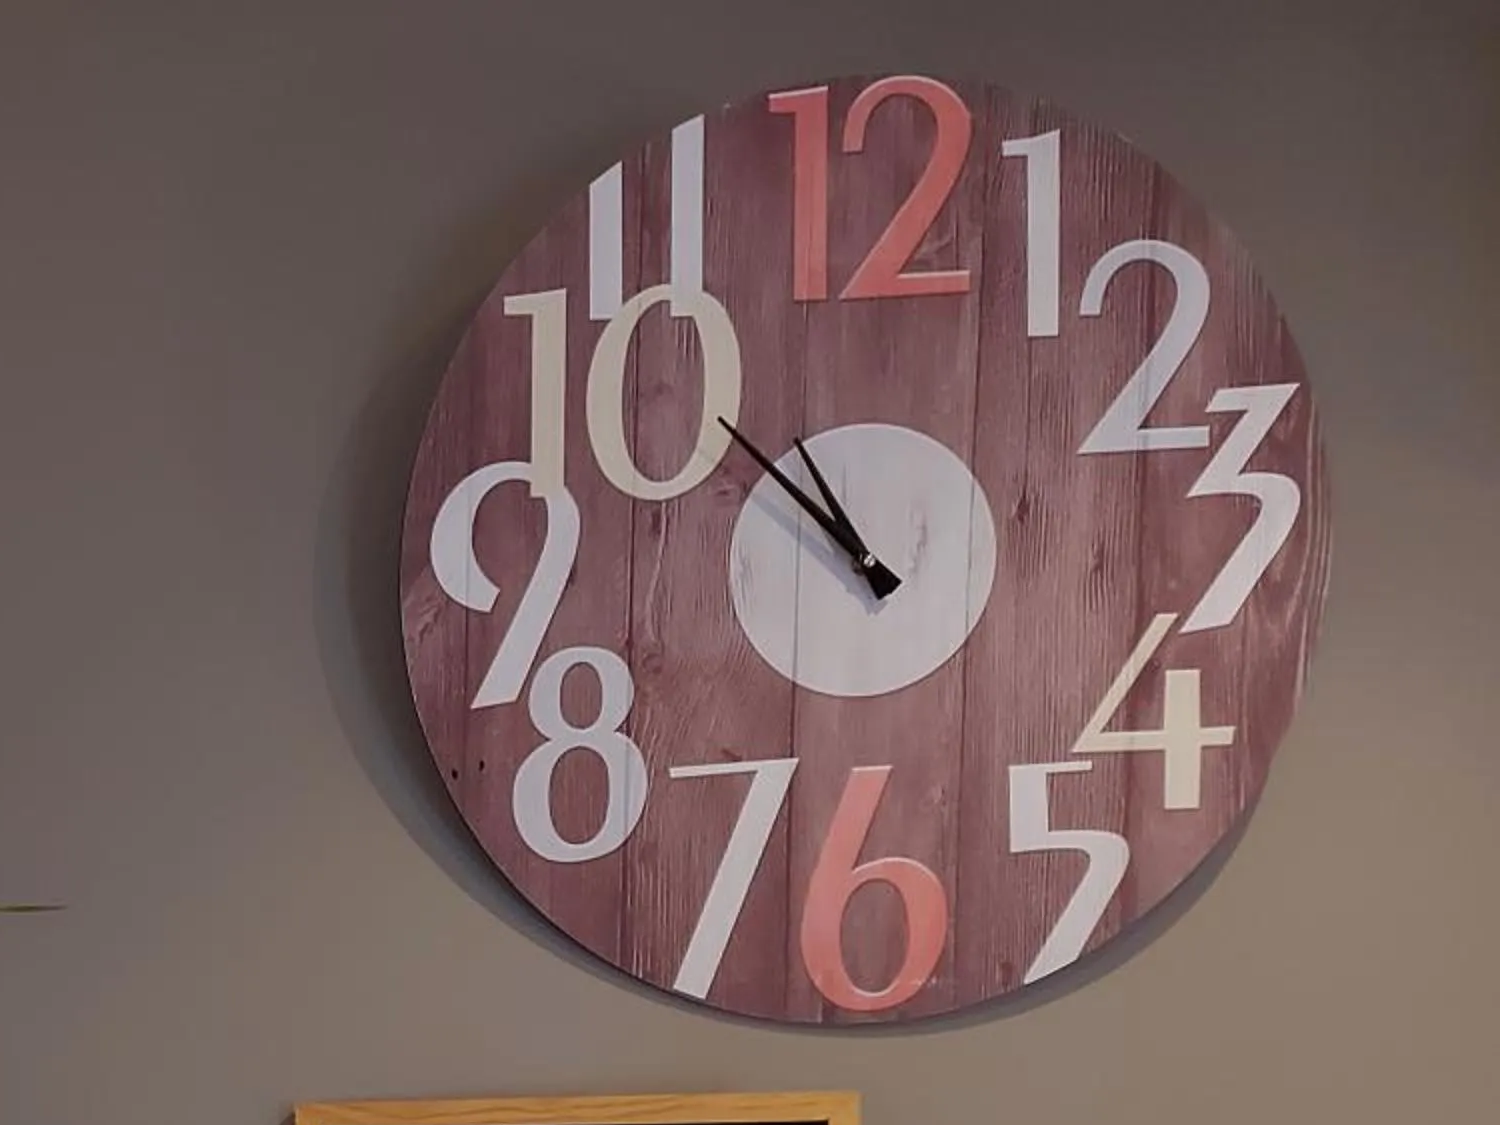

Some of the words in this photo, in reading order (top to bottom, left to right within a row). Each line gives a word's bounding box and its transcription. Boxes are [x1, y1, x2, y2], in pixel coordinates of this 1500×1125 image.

[589, 114, 704, 320] 11
[768, 75, 974, 302] 12
[1002, 130, 1060, 337] 1
[503, 284, 742, 501] 10
[1078, 239, 1211, 455] 2
[430, 461, 581, 709] 9
[1178, 384, 1300, 634] 3
[512, 647, 648, 862] 8
[1071, 612, 1236, 809] 4
[669, 757, 800, 999] 7
[800, 765, 948, 1011] 6
[1009, 760, 1130, 985] 5
